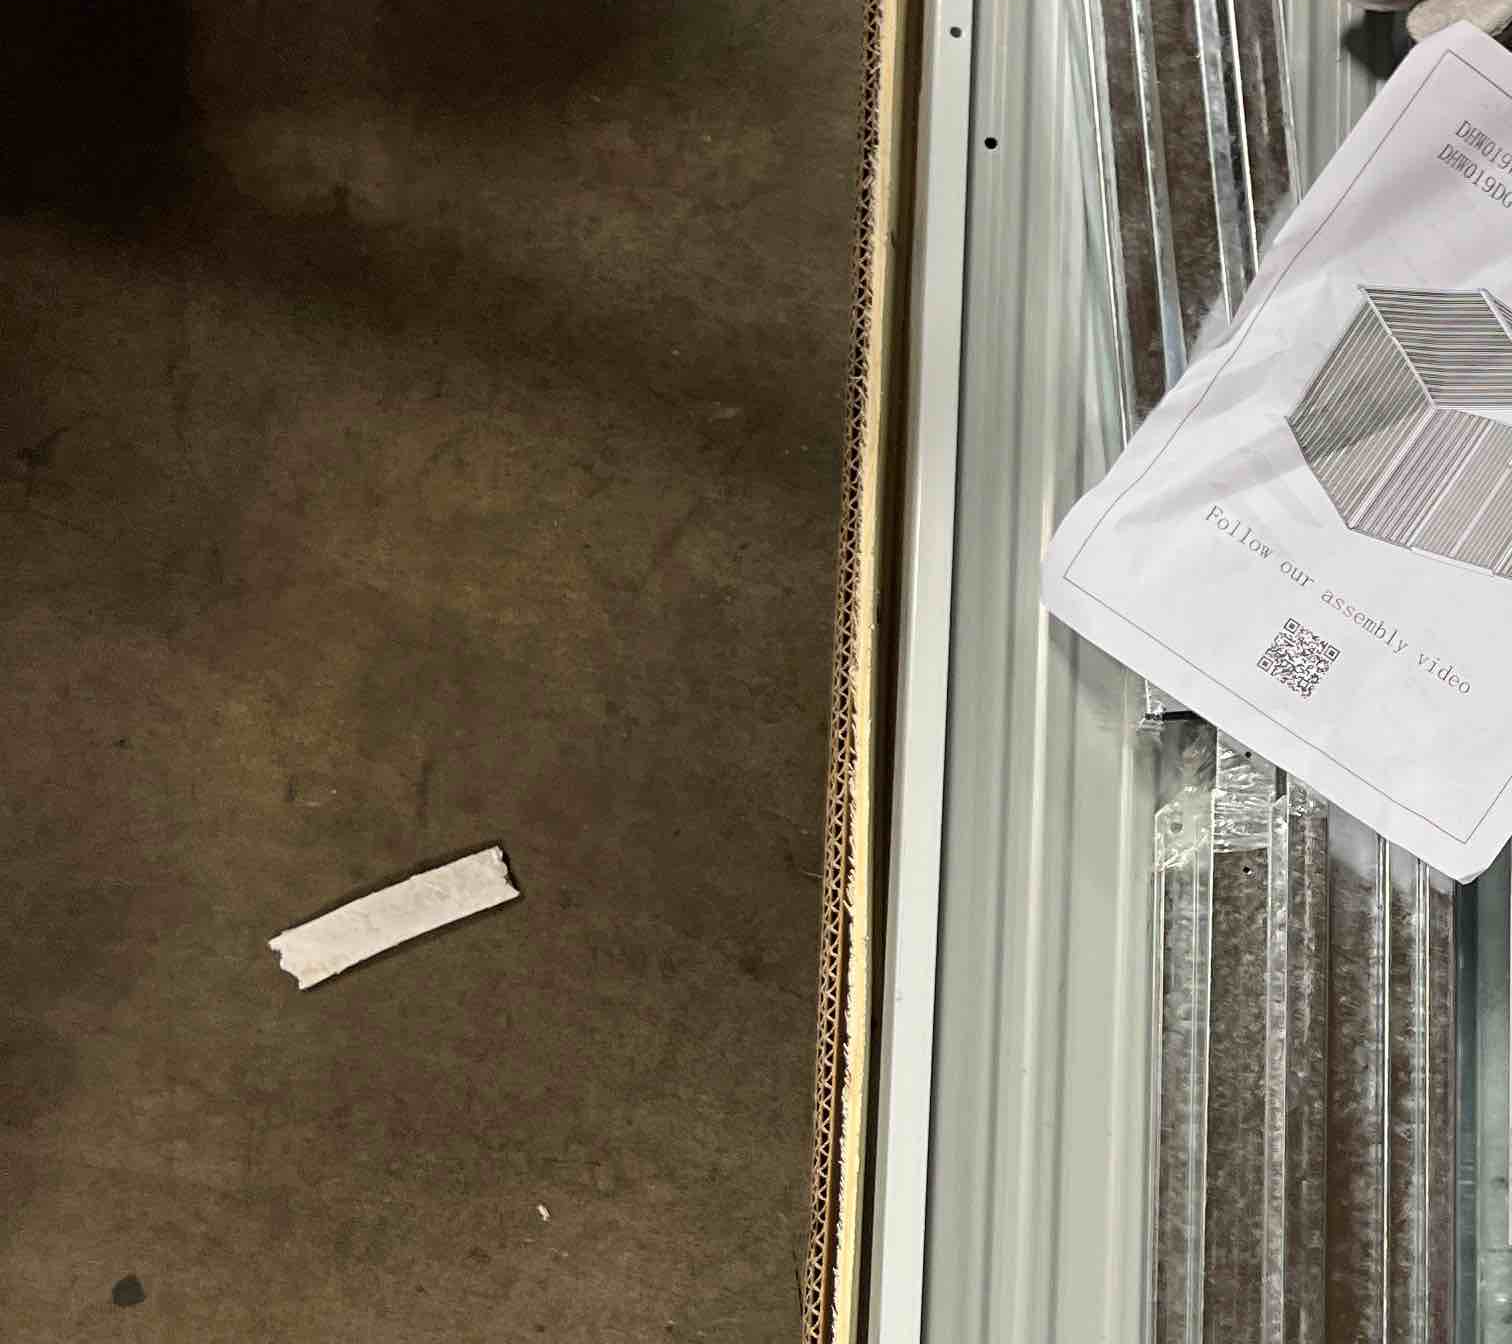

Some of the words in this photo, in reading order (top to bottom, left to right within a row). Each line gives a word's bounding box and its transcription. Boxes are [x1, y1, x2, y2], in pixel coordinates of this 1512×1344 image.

[1205, 505, 1273, 559] Follow
[1280, 559, 1314, 587] our
[1320, 589, 1409, 654] assembly
[1417, 652, 1471, 694] video
